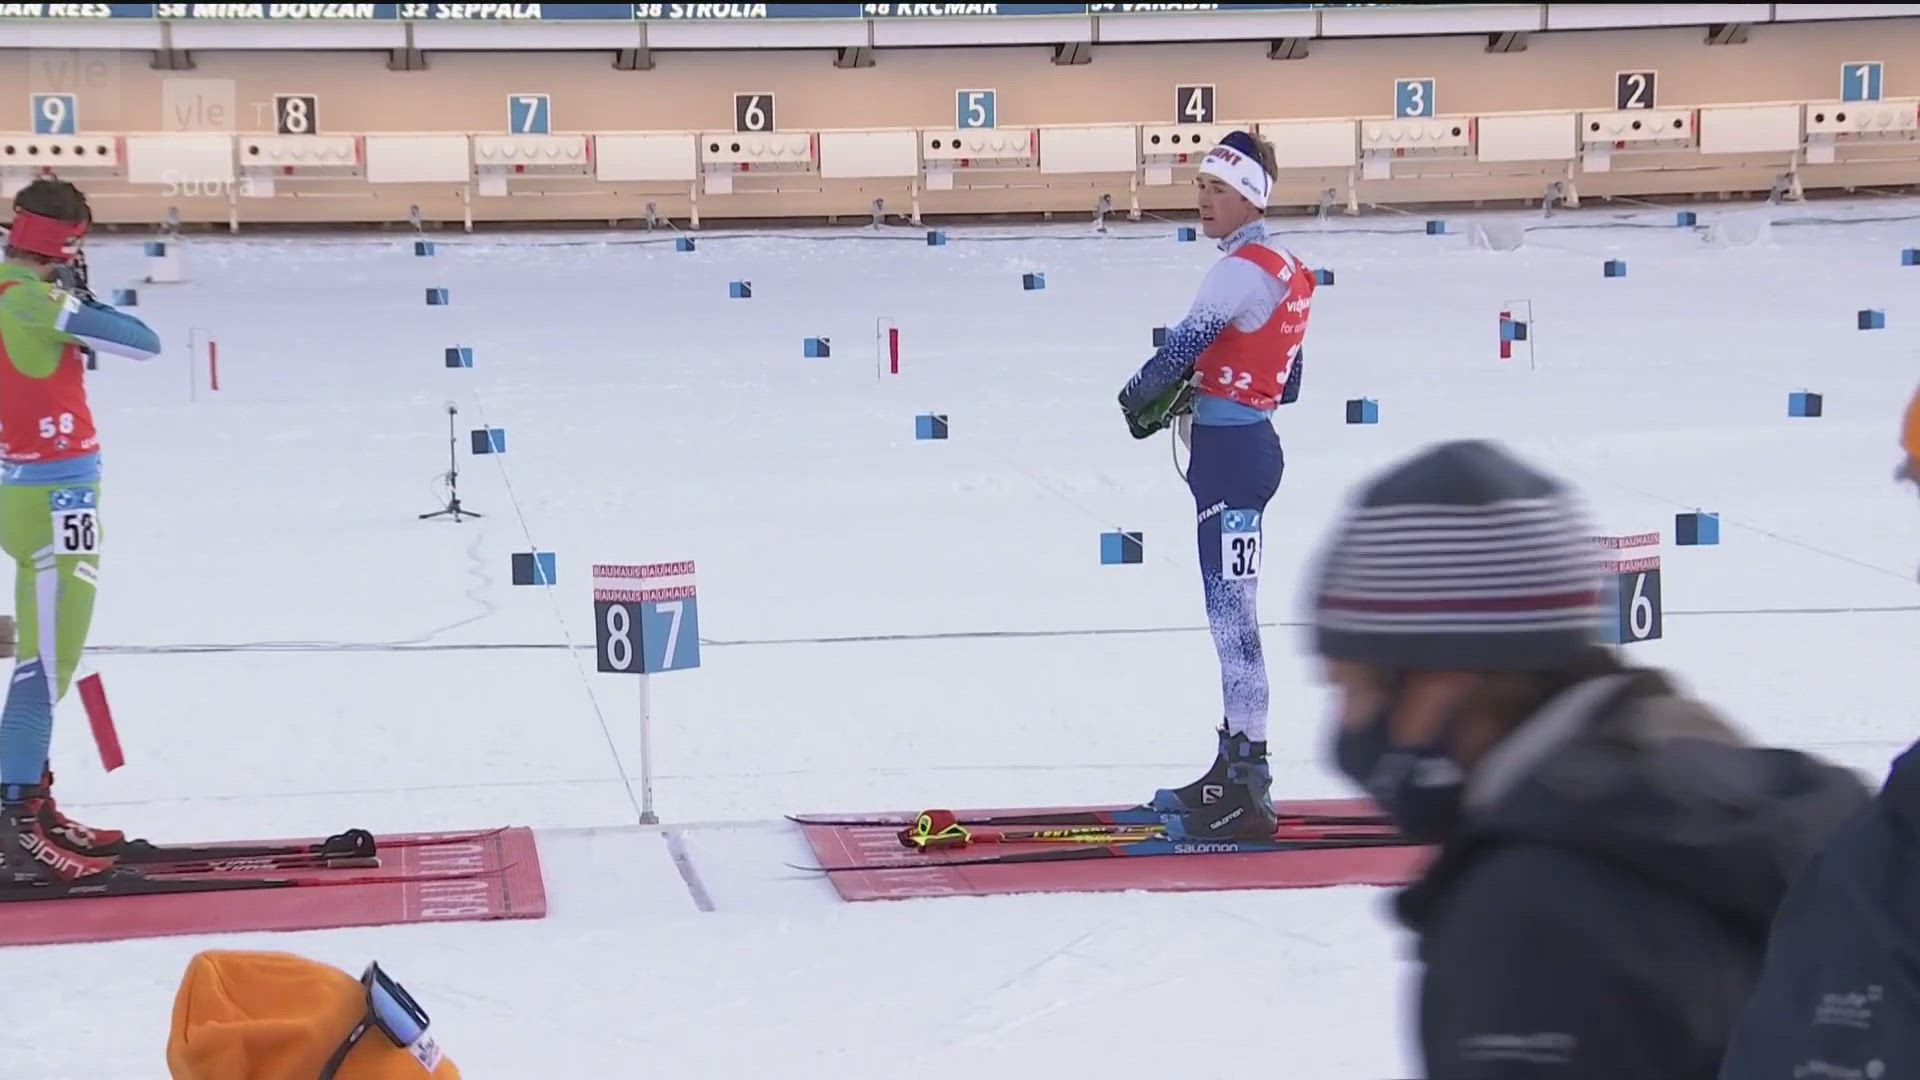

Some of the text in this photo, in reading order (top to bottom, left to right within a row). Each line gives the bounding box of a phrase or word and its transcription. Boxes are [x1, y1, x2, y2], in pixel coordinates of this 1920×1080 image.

[0, 3, 43, 17] AN
[192, 3, 262, 17] MIHA
[402, 3, 427, 17] 32
[1405, 82, 1425, 116] 3
[1626, 74, 1646, 108] 2
[1855, 65, 1871, 100] 1
[42, 97, 65, 133] 9
[286, 98, 308, 132] 8
[519, 98, 539, 132] 7
[744, 96, 765, 130] 6
[967, 93, 986, 127] 5
[1185, 88, 1207, 122] 4
[1218, 366, 1252, 390] 32
[39, 412, 75, 438] 58
[63, 514, 95, 550] 58
[593, 560, 695, 578] BAUHAUS BAUHAUS
[1231, 537, 1256, 576] 32
[1630, 573, 1653, 639] 6
[607, 600, 684, 671] 8 7
[1174, 842, 1239, 854] salomon
